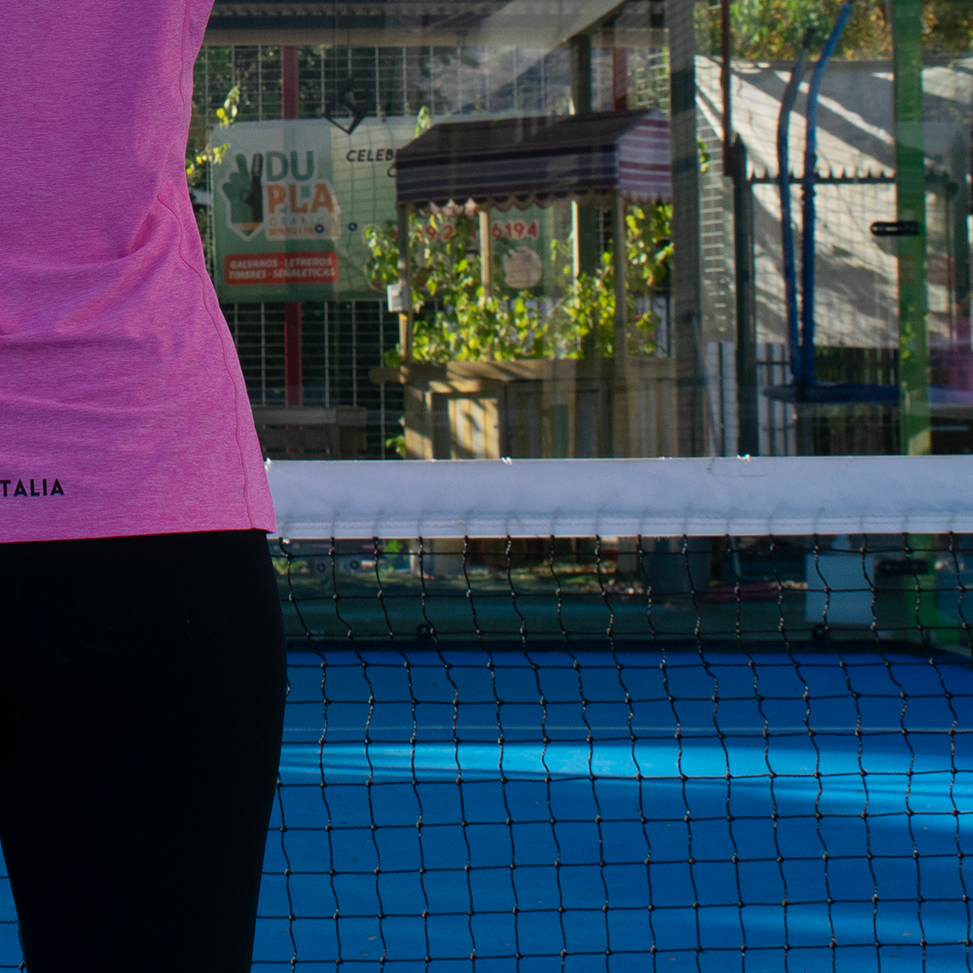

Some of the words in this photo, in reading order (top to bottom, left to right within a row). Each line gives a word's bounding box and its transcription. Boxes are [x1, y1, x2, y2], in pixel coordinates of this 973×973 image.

[266, 151, 315, 182] DU
[266, 183, 335, 214] PLA
[492, 222, 538, 239] 6194
